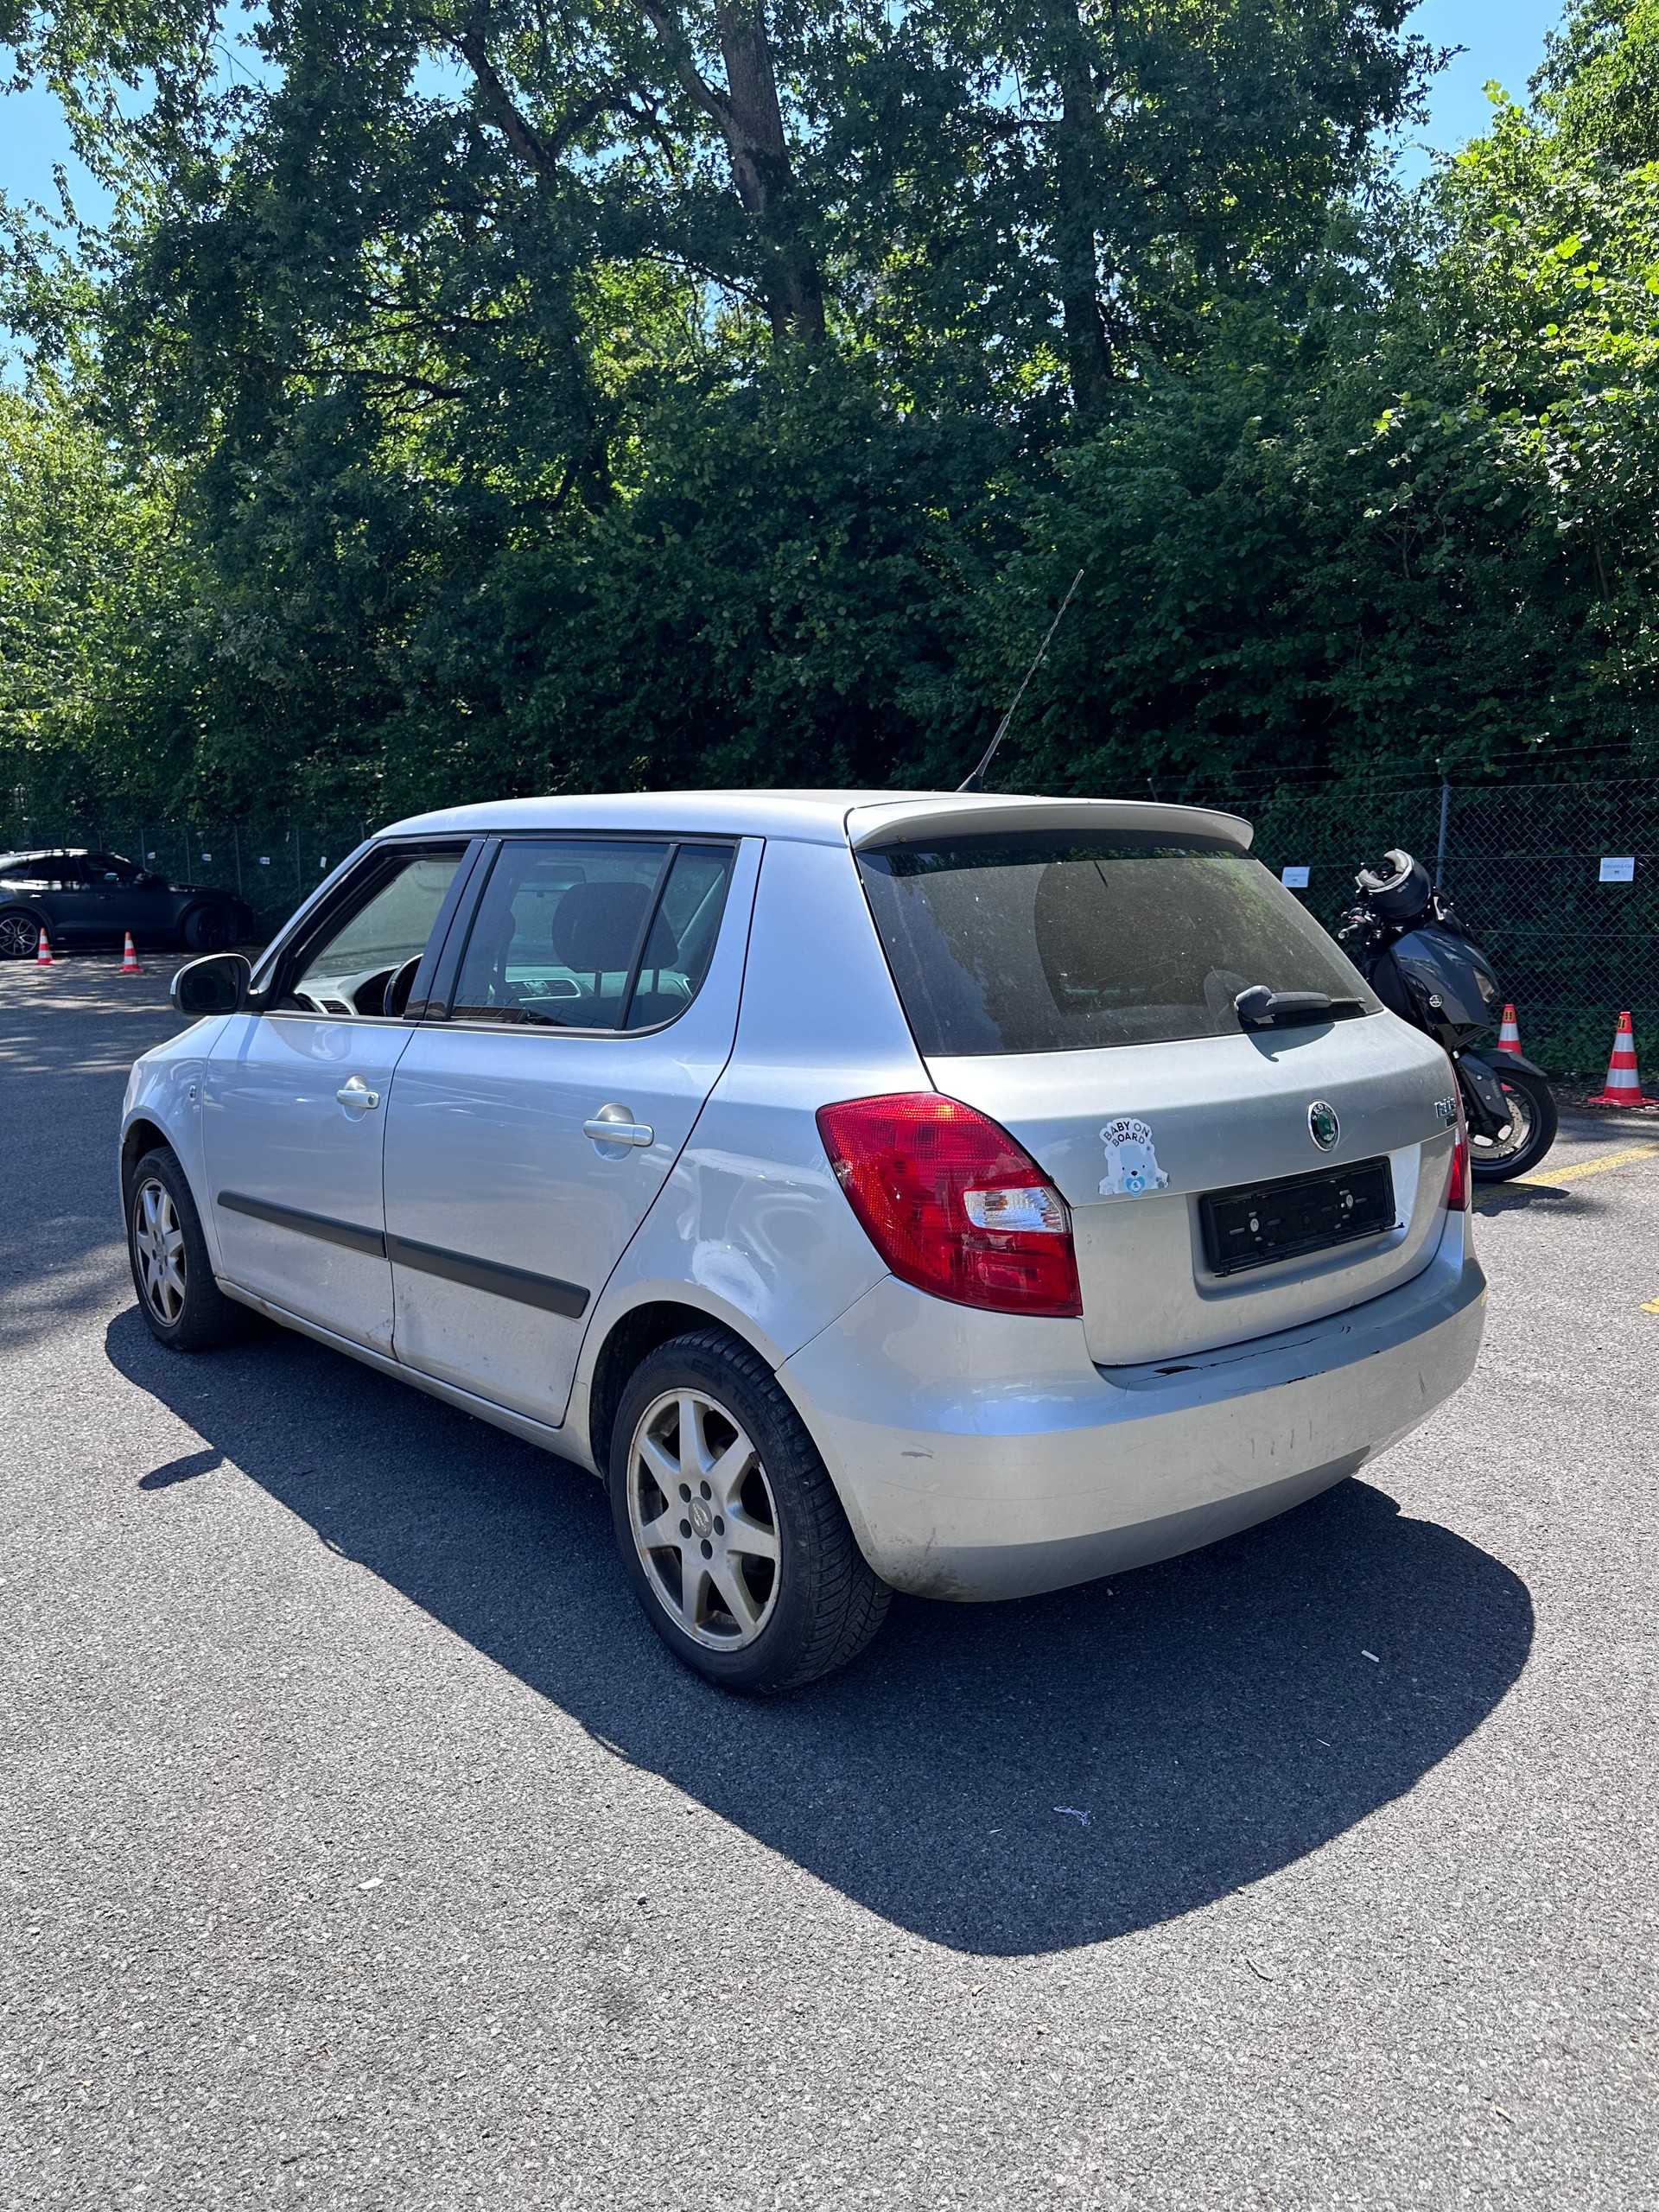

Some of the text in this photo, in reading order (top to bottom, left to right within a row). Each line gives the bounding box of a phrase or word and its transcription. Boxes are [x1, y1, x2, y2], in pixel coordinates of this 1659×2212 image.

[1103, 1121, 1150, 1141] BABY ON
[1111, 1132, 1145, 1147] BOARD
